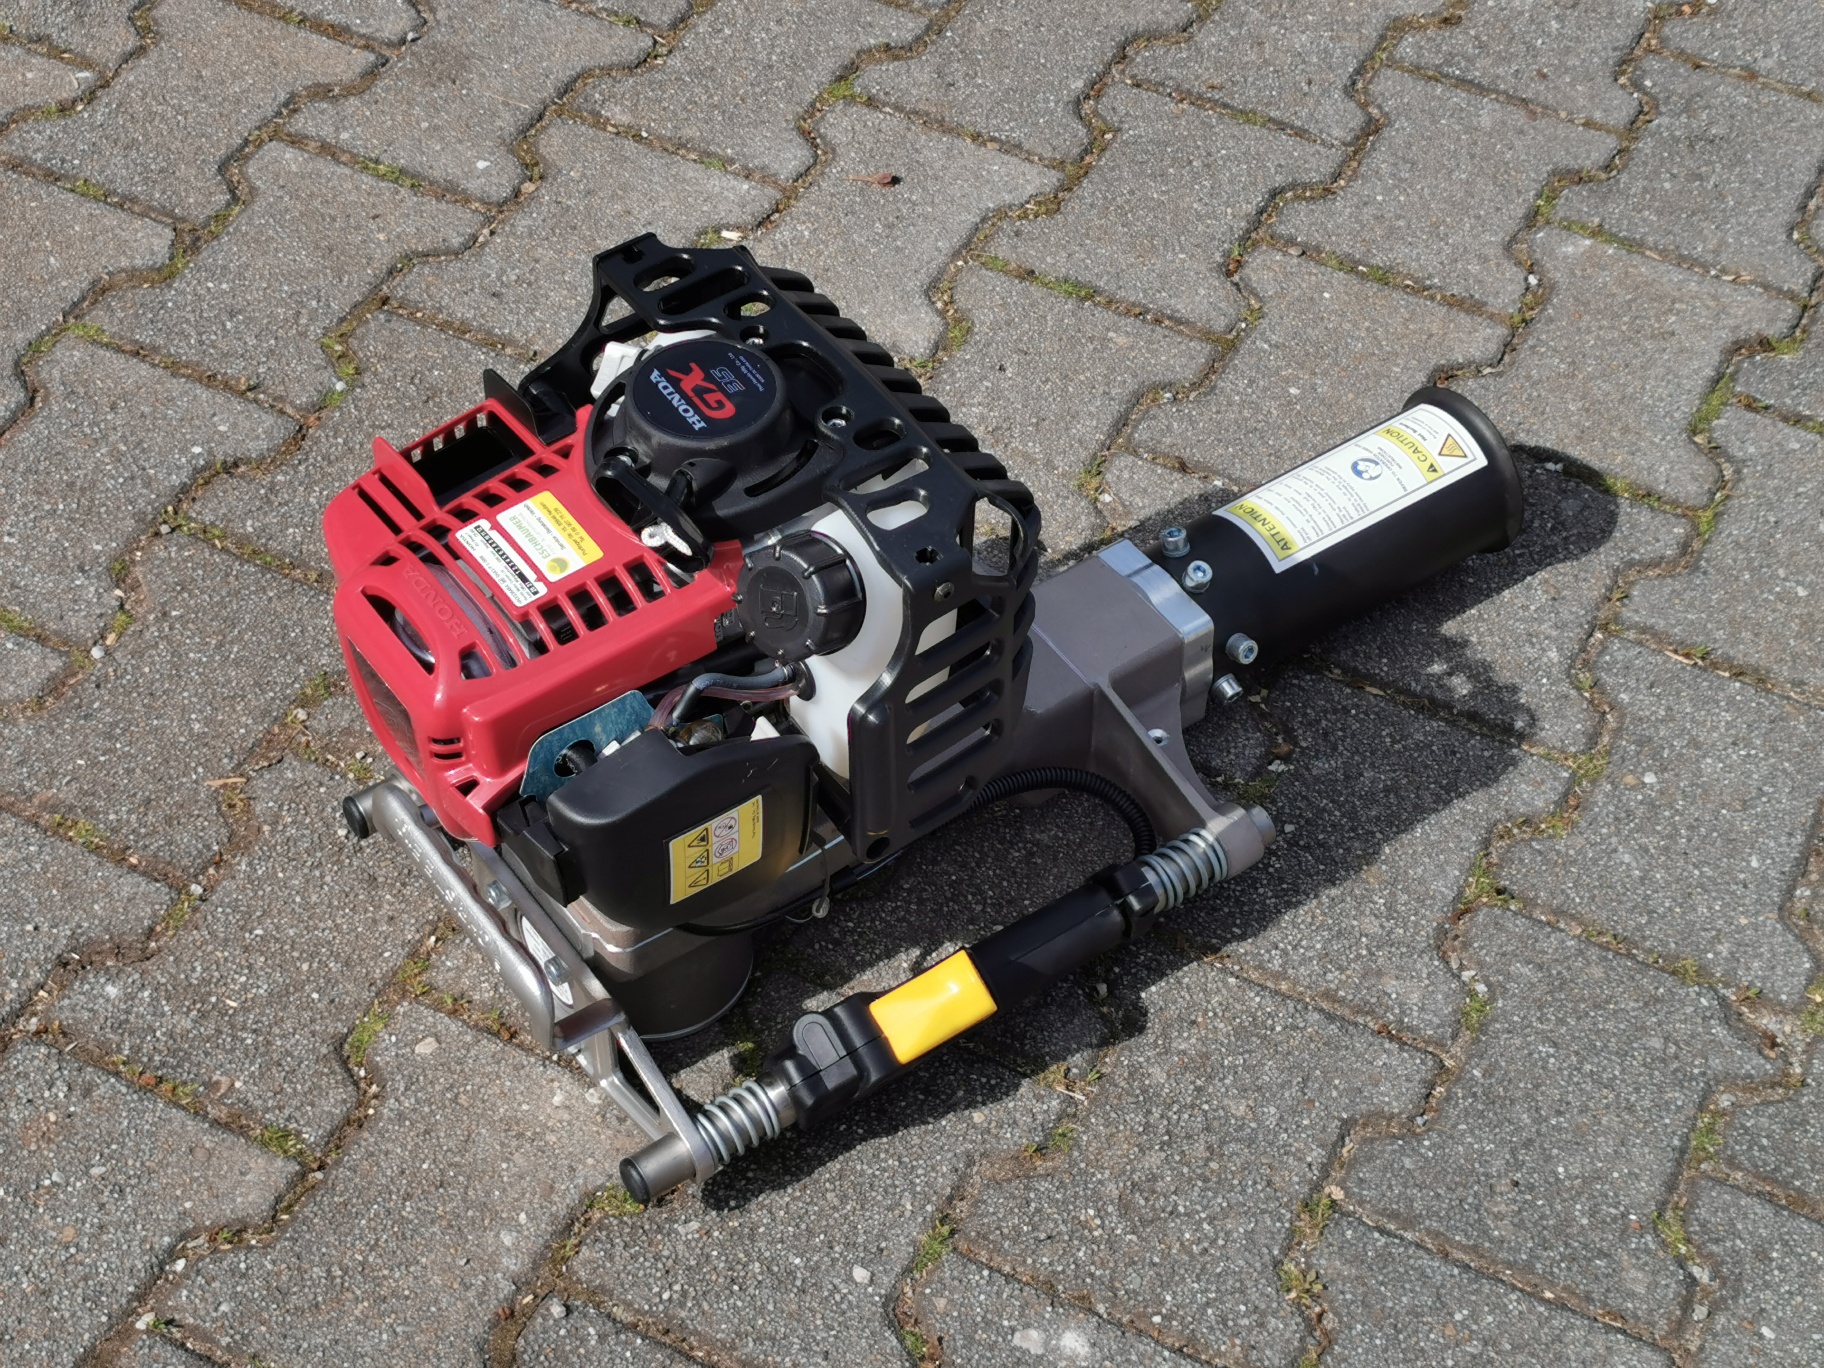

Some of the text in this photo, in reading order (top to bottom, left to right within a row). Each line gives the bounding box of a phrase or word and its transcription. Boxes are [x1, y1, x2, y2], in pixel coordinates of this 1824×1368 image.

[649, 367, 707, 430] HONDA
[665, 362, 736, 419] GX
[709, 364, 745, 393] 35
[1380, 428, 1428, 463] CAUTION
[458, 534, 476, 551] HONDA
[508, 514, 551, 559] ESCHBAUMER
[535, 516, 552, 534] Beratung
[550, 535, 566, 550] Service
[1234, 503, 1291, 549] ATTENTION
[402, 561, 467, 638] HONDA
